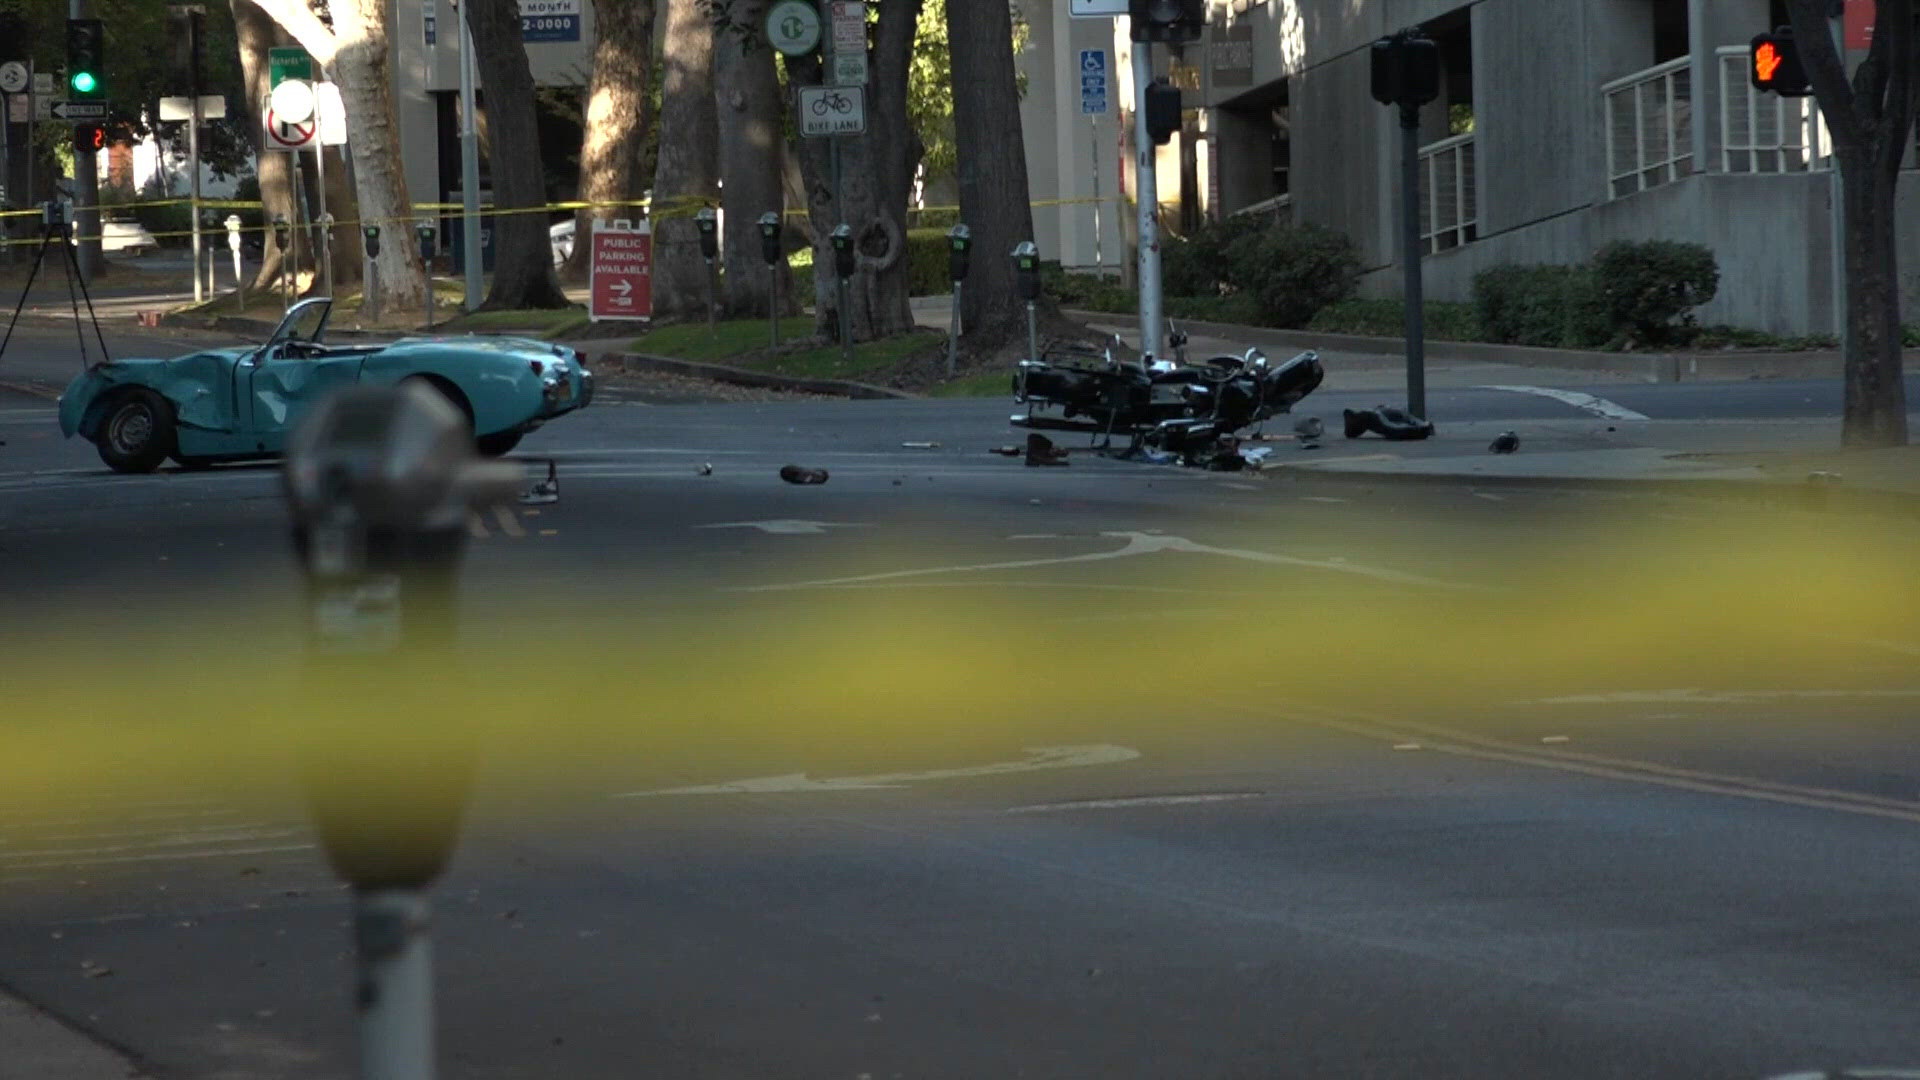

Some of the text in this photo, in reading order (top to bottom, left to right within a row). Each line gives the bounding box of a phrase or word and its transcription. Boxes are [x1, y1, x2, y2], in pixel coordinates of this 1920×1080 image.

[528, 3, 571, 12] MONTH
[808, 121, 858, 132] BIKE LANE
[603, 239, 641, 248] PUBLIC
[599, 252, 645, 261] PARKING
[595, 265, 649, 274] AVAILABLE
